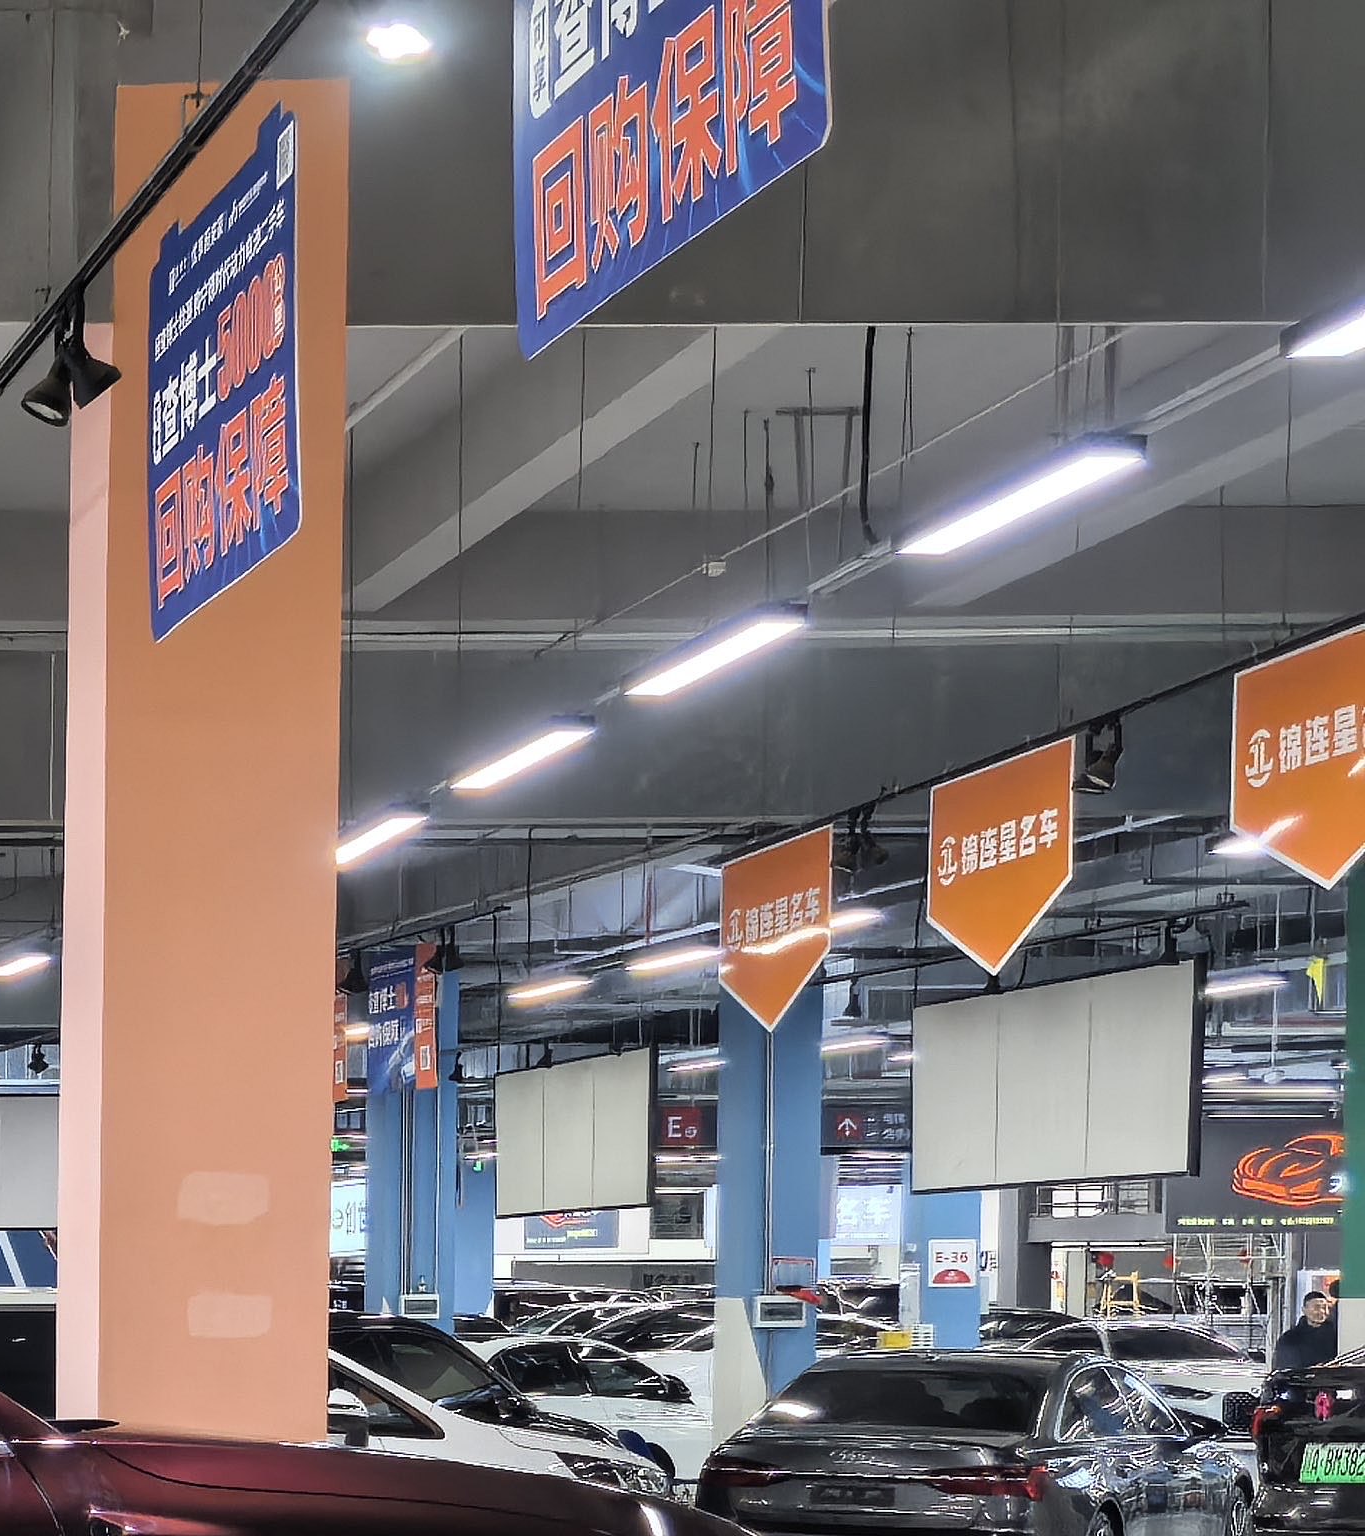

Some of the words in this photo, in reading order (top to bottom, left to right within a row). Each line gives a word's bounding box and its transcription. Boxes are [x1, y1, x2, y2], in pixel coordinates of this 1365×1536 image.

[532, 0, 798, 321] 回购保障
[155, 374, 289, 609] 回购保障
[1279, 704, 1365, 773] 锦连星
[961, 808, 1058, 875] 锦连星名车
